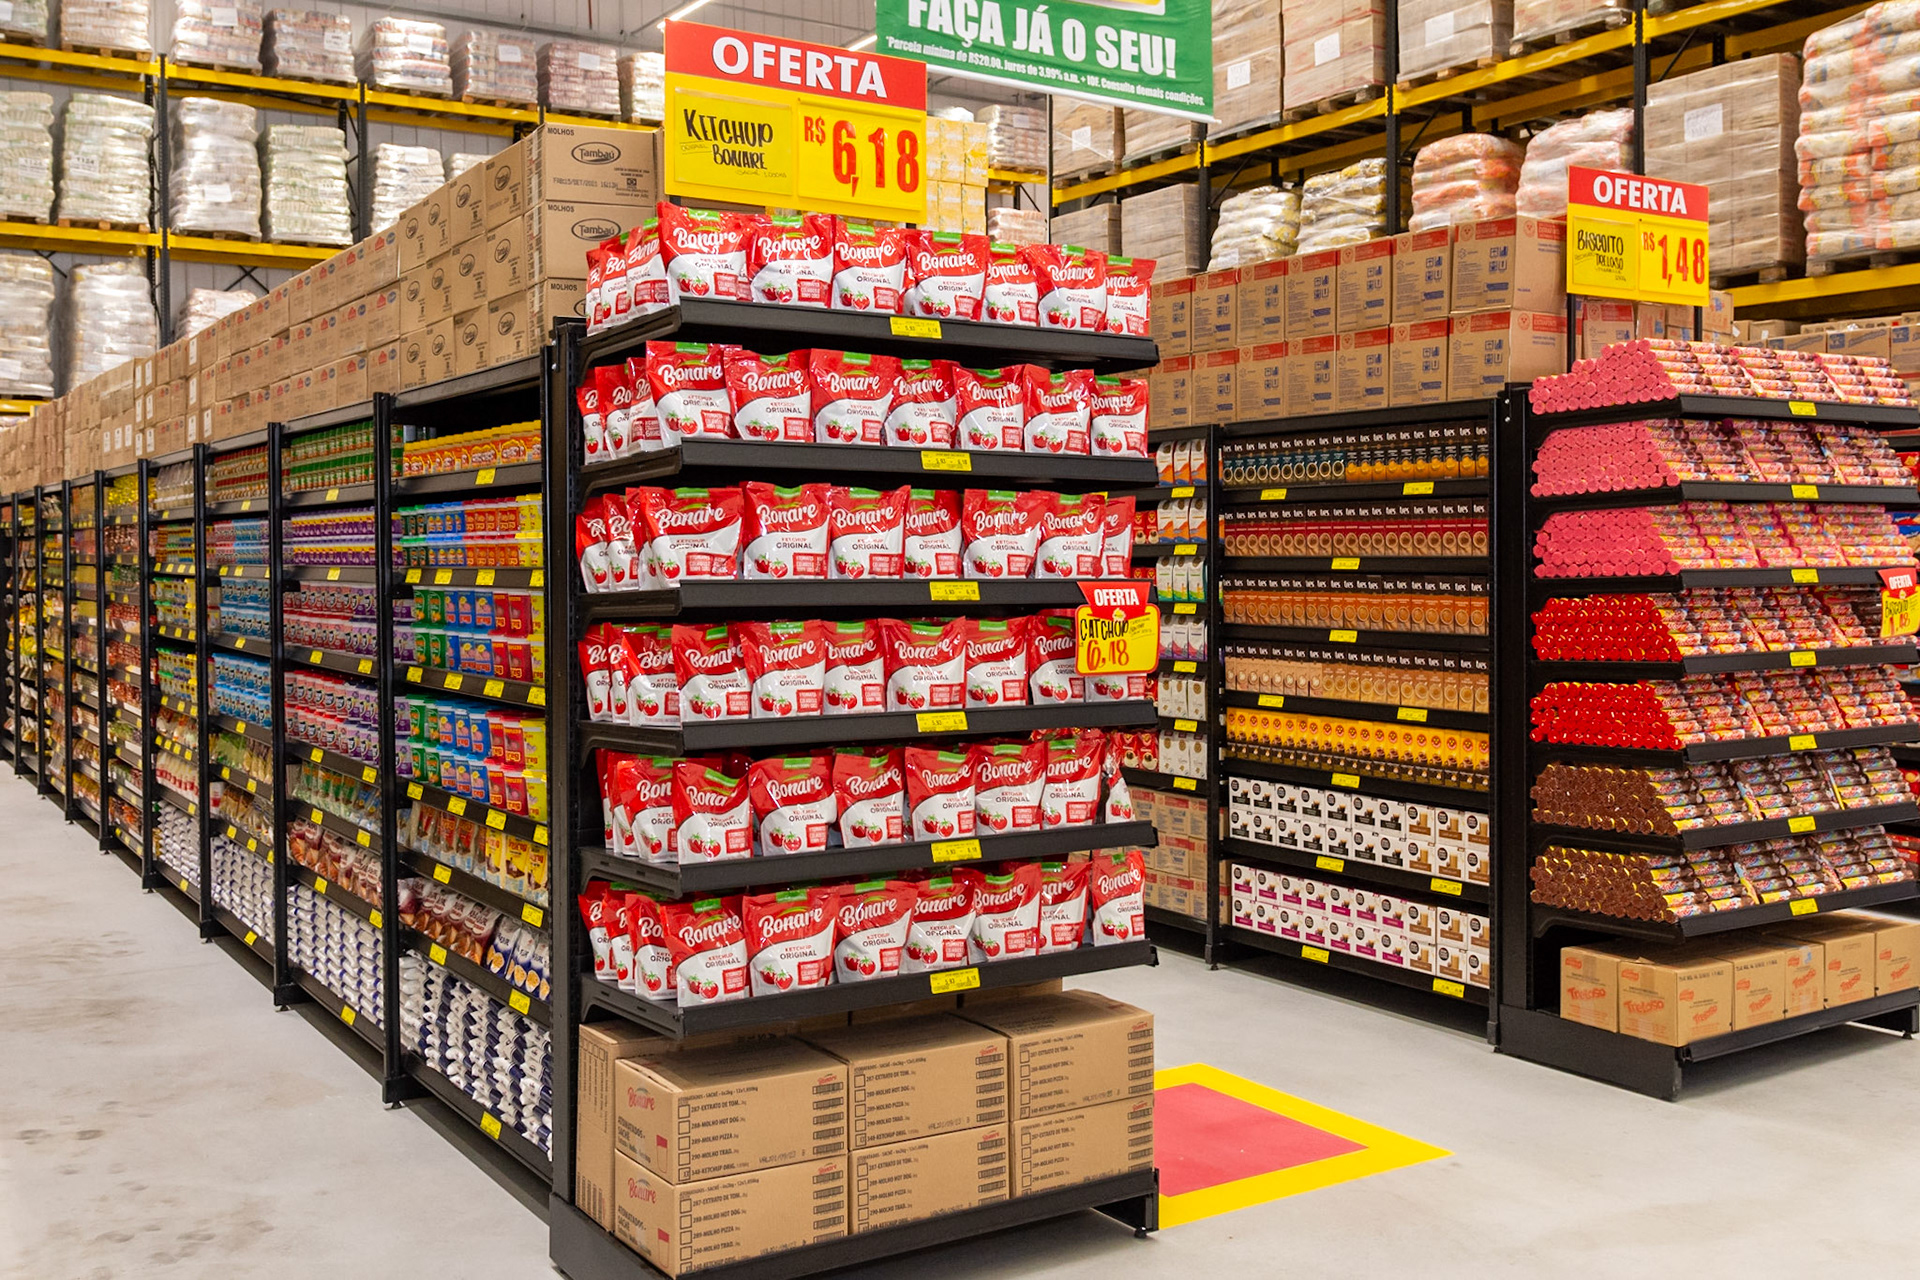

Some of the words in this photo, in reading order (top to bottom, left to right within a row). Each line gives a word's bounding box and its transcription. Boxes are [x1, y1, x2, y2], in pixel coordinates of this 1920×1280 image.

[908, 0, 1006, 48] FAÇA
[1012, 6, 1055, 57] JÁ
[1061, 18, 1087, 62] O
[1095, 25, 1177, 79] SEU!
[712, 36, 888, 99] OFERTA
[922, 44, 956, 60] mínima
[956, 50, 968, 62] de
[1004, 59, 1027, 74] Juros
[1027, 63, 1039, 77] de
[1063, 71, 1081, 84] a.m.
[1086, 75, 1101, 88] IOF.
[1101, 77, 1135, 95] Consulte
[1136, 85, 1165, 100] demais
[1165, 90, 1206, 106] condições.
[547, 127, 575, 136] MOLHOS
[683, 108, 773, 147] KETCHUP
[578, 147, 616, 161] Tambaú
[712, 144, 767, 170] BONARE
[803, 115, 826, 147] R$
[832, 119, 920, 198] 6,18
[1593, 175, 1687, 214] OFERTA
[547, 204, 575, 213] MOLHOS
[578, 224, 616, 238] Tambaú
[673, 227, 738, 248] Bonare
[757, 235, 823, 260] Bonare
[836, 242, 896, 261] Bonare
[1578, 229, 1624, 256] BISCOITO
[917, 250, 976, 271] Bonare
[1643, 231, 1655, 252] R$
[1658, 234, 1705, 288] 1,48
[857, 276, 891, 284] ORIGINAL
[1048, 264, 1095, 282] Bonare
[550, 283, 578, 292] MOLHOS
[658, 364, 723, 386] Bonare
[742, 370, 803, 392] Bonare
[827, 372, 880, 393] Bonare
[893, 376, 943, 395] Bonare
[968, 381, 1021, 401] Bonare
[1091, 393, 1136, 409] Bonare
[655, 504, 726, 529] Bonare
[757, 504, 818, 525] Bonare
[832, 506, 895, 528] Bonare
[973, 510, 1028, 532] Bonare
[1044, 510, 1095, 530] Bonare
[1889, 574, 1912, 590] OFERTA
[1094, 589, 1139, 606] OFERTA
[686, 645, 744, 668] Bonare
[760, 640, 816, 664] Bonare
[826, 638, 876, 659] Bonare
[894, 636, 952, 659] Bonare
[967, 636, 1016, 658] Bonare
[1087, 639, 1129, 671] 6,18
[922, 765, 971, 788] Bonare
[977, 759, 1034, 783] Bonare
[1047, 756, 1092, 776] onare
[637, 779, 671, 801] Bon
[767, 775, 824, 800] Bonare
[846, 768, 901, 796] Bonare
[1098, 868, 1141, 894] Bonare
[974, 883, 1025, 908] Bonare
[759, 907, 823, 938] Bonare
[839, 899, 897, 927] Bonare
[679, 915, 742, 948] Bonare
[863, 938, 896, 947] ORIGINAL
[705, 957, 741, 968] ORIGINAL
[780, 950, 817, 960] ORIGINAL
